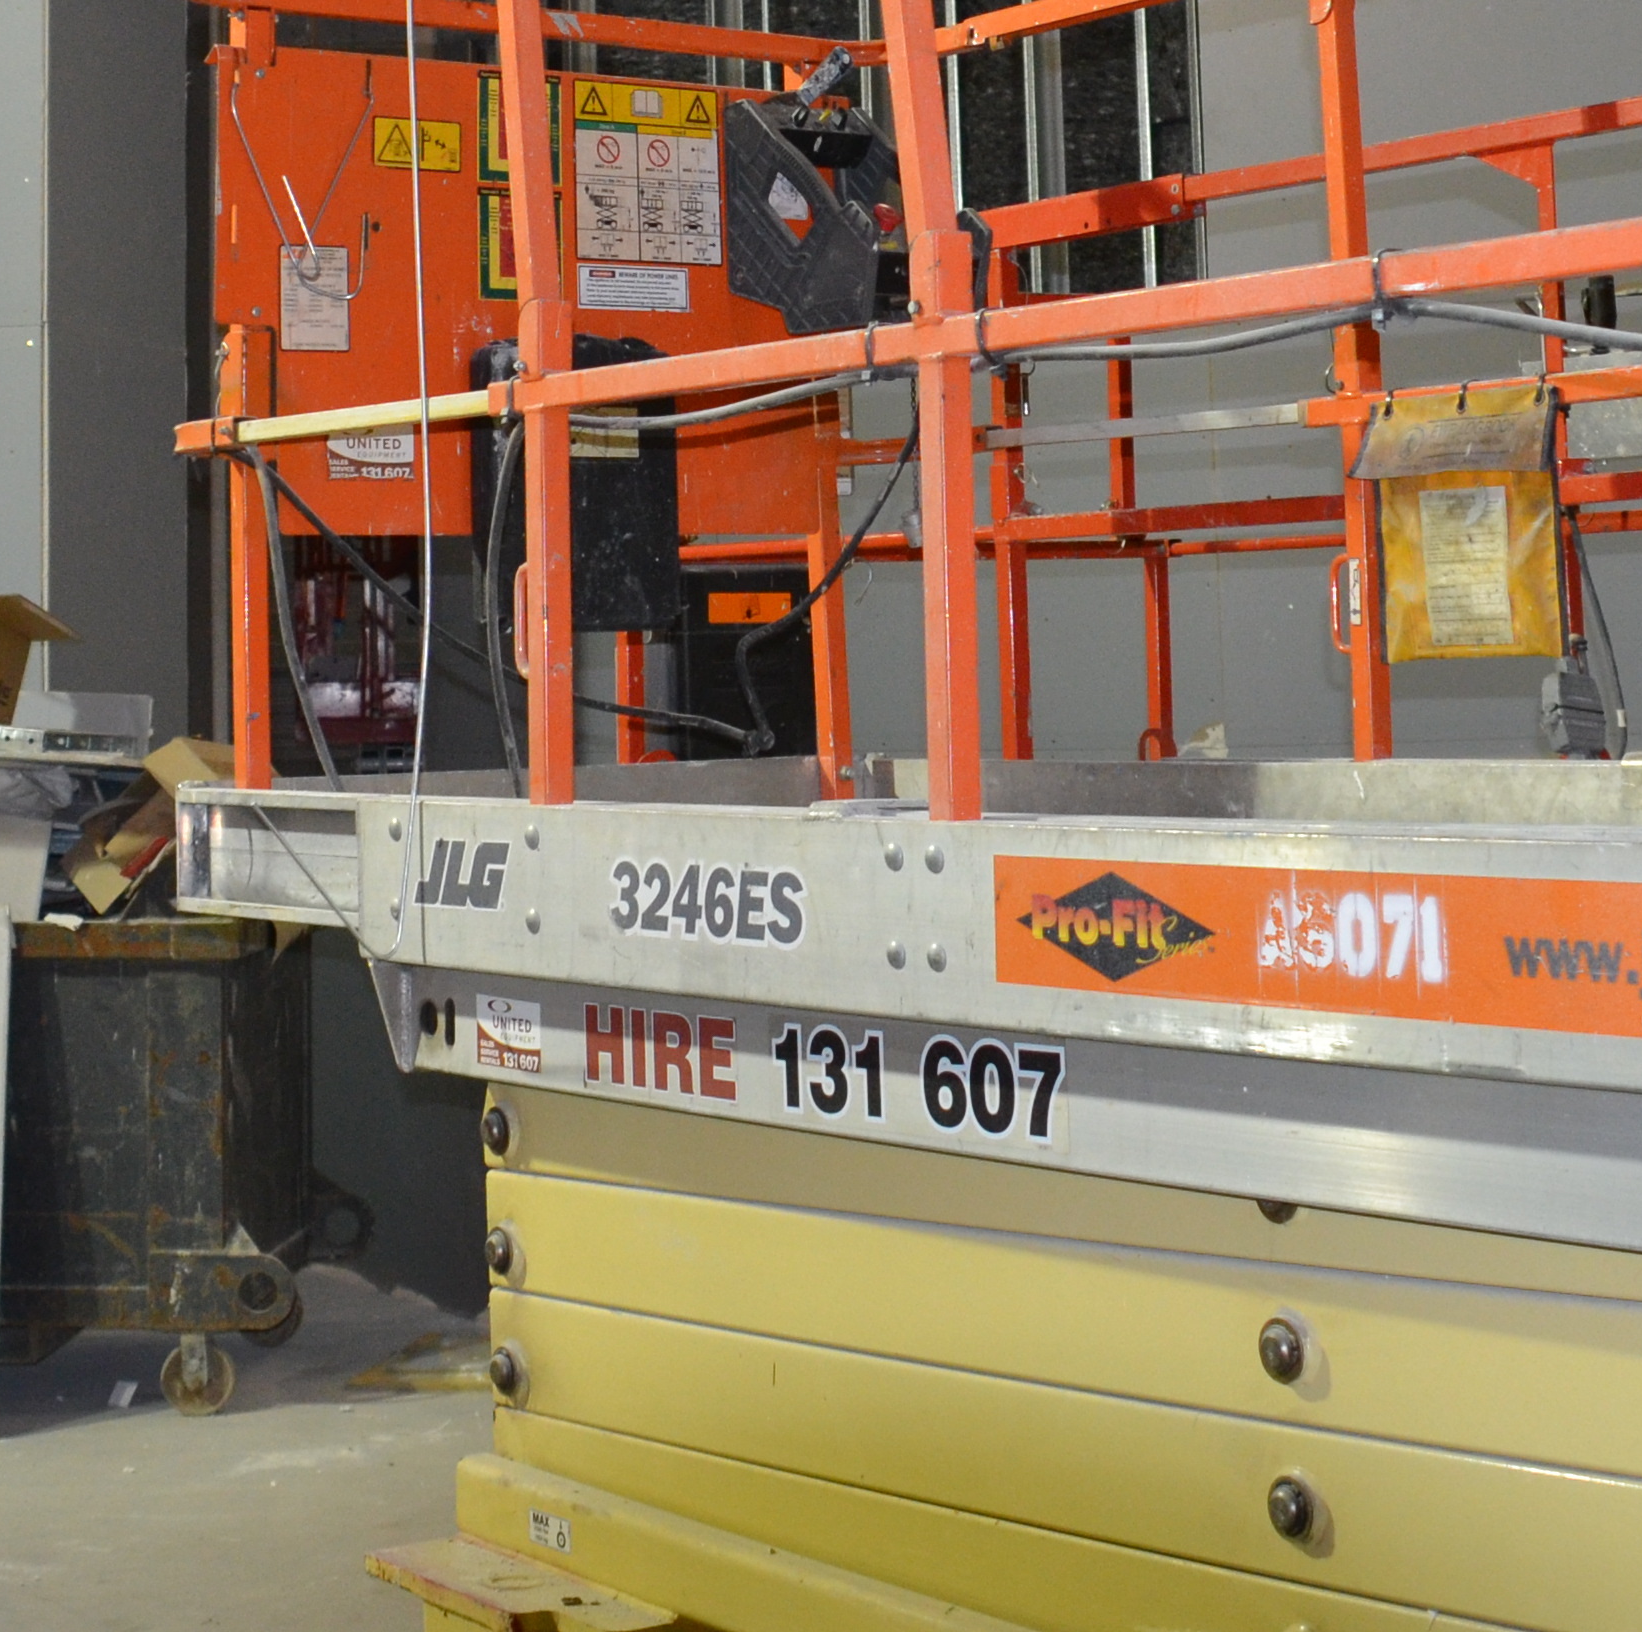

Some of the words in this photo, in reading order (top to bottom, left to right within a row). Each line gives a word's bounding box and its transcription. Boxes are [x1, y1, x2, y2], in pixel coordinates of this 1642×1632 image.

[346, 437, 402, 449] UNITED
[415, 841, 509, 910] JLG
[610, 859, 807, 951] 3246ES
[1031, 894, 1166, 950] Pro-Fit
[492, 1015, 532, 1033] UNITED
[583, 1002, 738, 1102] HIRE
[503, 1052, 518, 1068] 131
[519, 1054, 539, 1072] 607
[771, 1022, 887, 1122] 131
[920, 1037, 1066, 1143] 607
[532, 1512, 550, 1528] MAX
